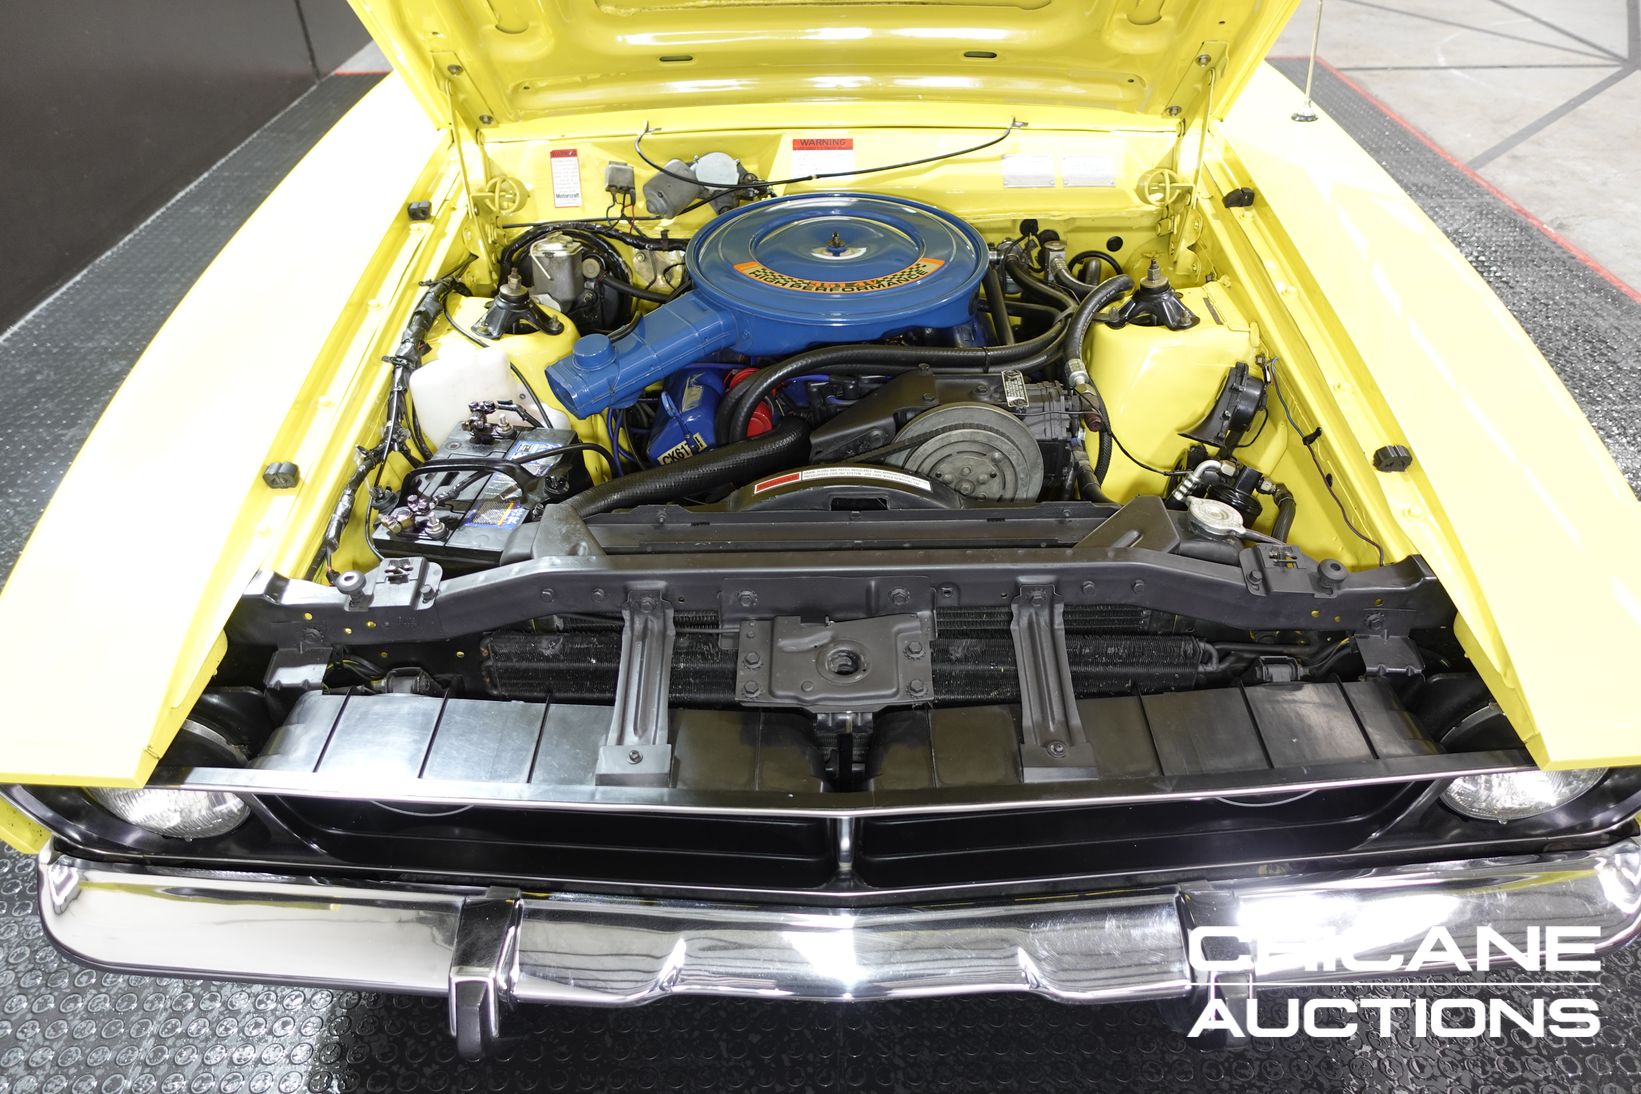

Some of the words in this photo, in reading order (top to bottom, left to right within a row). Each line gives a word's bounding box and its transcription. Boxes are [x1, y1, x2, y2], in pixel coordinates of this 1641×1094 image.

[799, 138, 847, 146] WARNING
[749, 269, 787, 286] HIGH
[790, 270, 928, 292] PERFORMANCE
